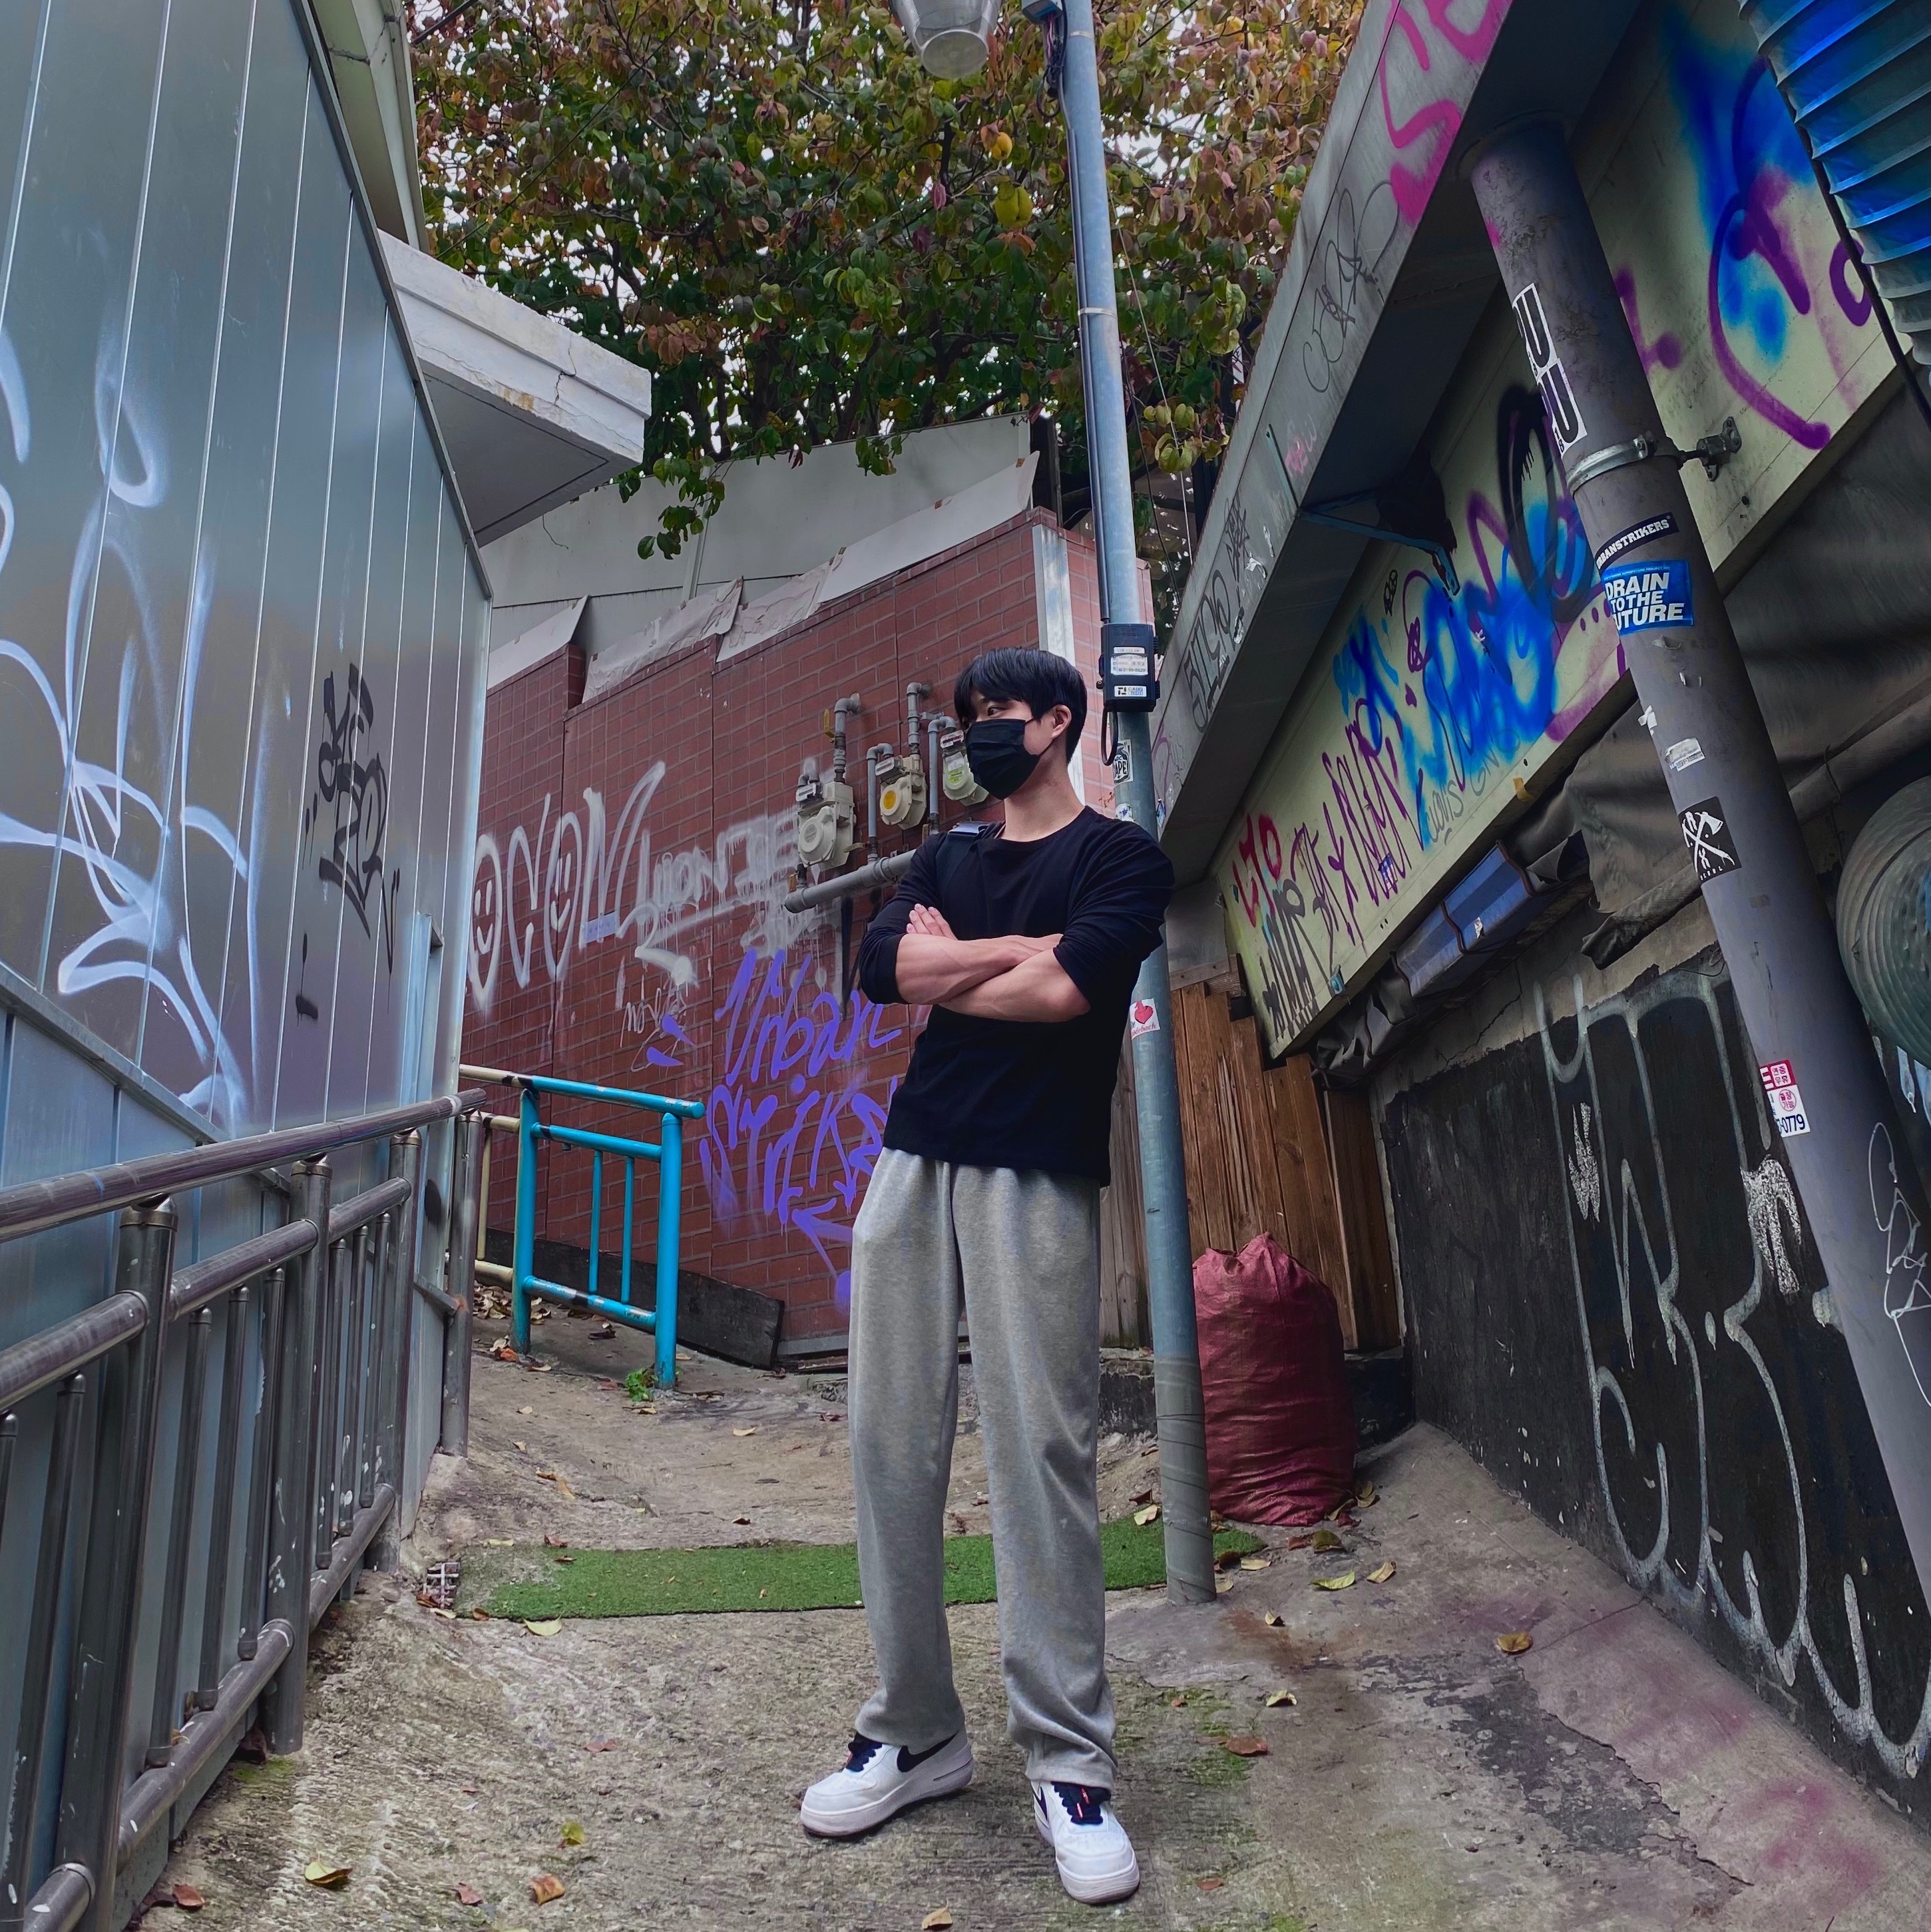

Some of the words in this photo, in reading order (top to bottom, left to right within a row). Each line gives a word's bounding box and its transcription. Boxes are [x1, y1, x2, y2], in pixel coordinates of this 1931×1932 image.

[1605, 573, 1669, 600] DRAIN
[1611, 597, 1625, 612] TO
[1625, 591, 1664, 608] THE
[1611, 603, 1685, 630] UTURE
